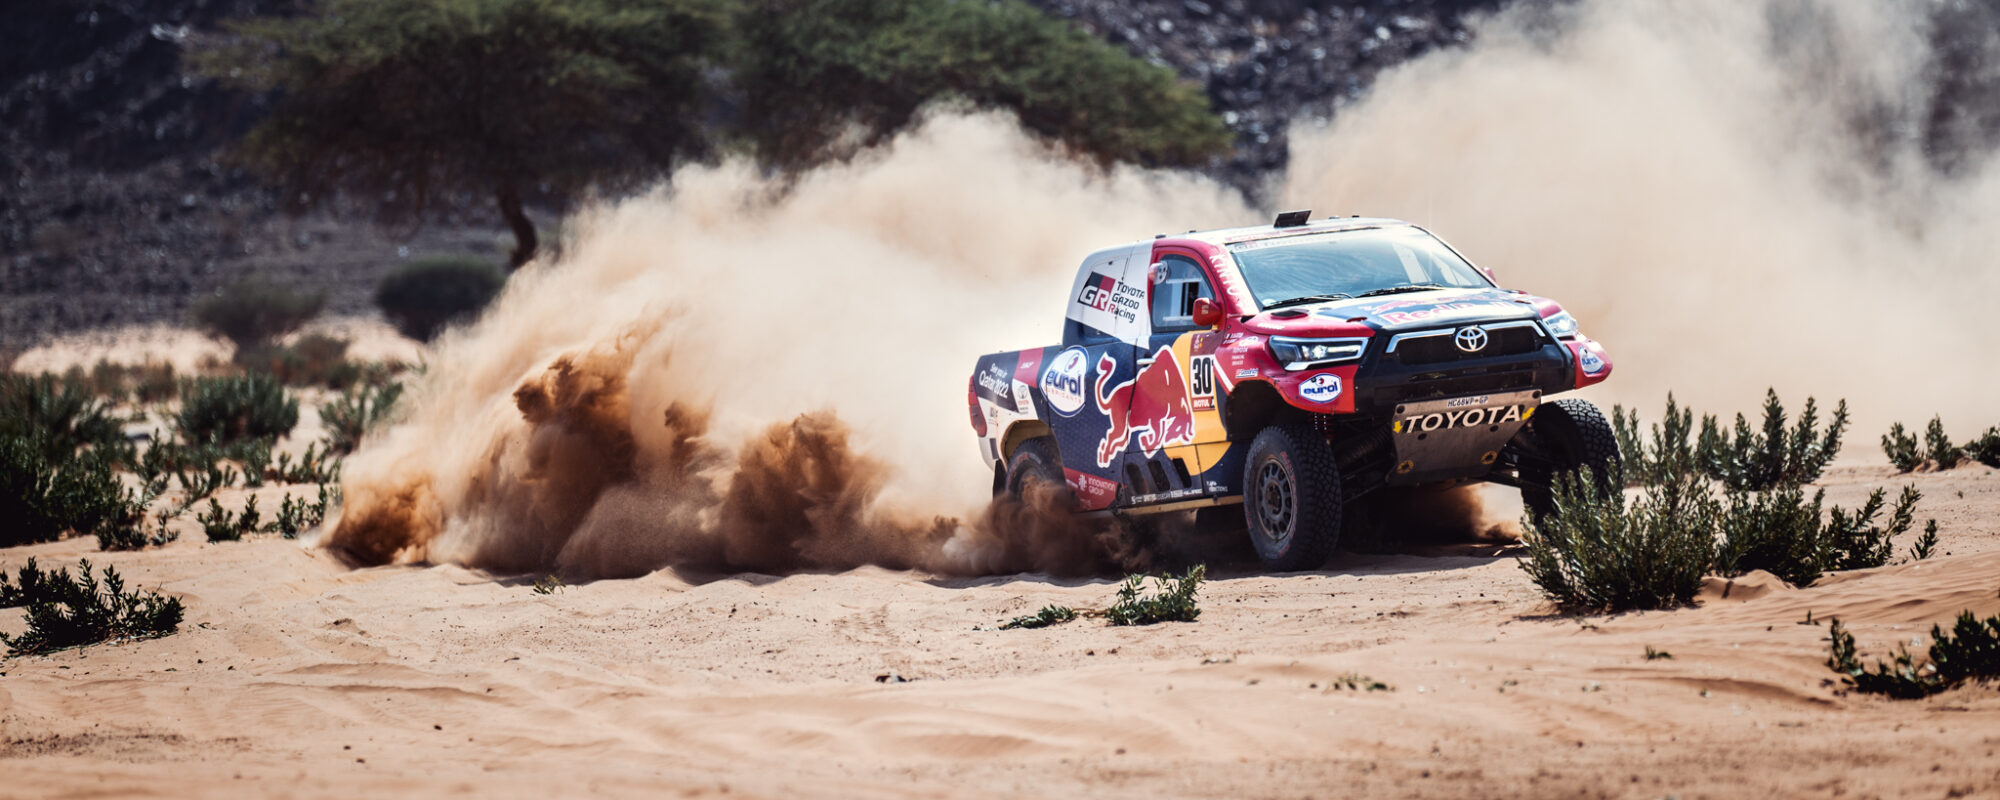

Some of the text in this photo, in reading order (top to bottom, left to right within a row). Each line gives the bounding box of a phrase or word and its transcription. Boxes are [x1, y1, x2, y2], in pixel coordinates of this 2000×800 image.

[1079, 285, 1110, 311] GR
[1117, 281, 1145, 299] TOYOTA
[1111, 293, 1140, 310] GAZOO
[1107, 303, 1136, 324] Racing
[1383, 303, 1451, 323] Red
[979, 370, 1009, 399] Qatar 2022
[1045, 369, 1081, 397] eurol
[1303, 381, 1338, 394] eurol
[1193, 399, 1210, 409] MOTUL
[1404, 404, 1521, 434] TOYOTA
